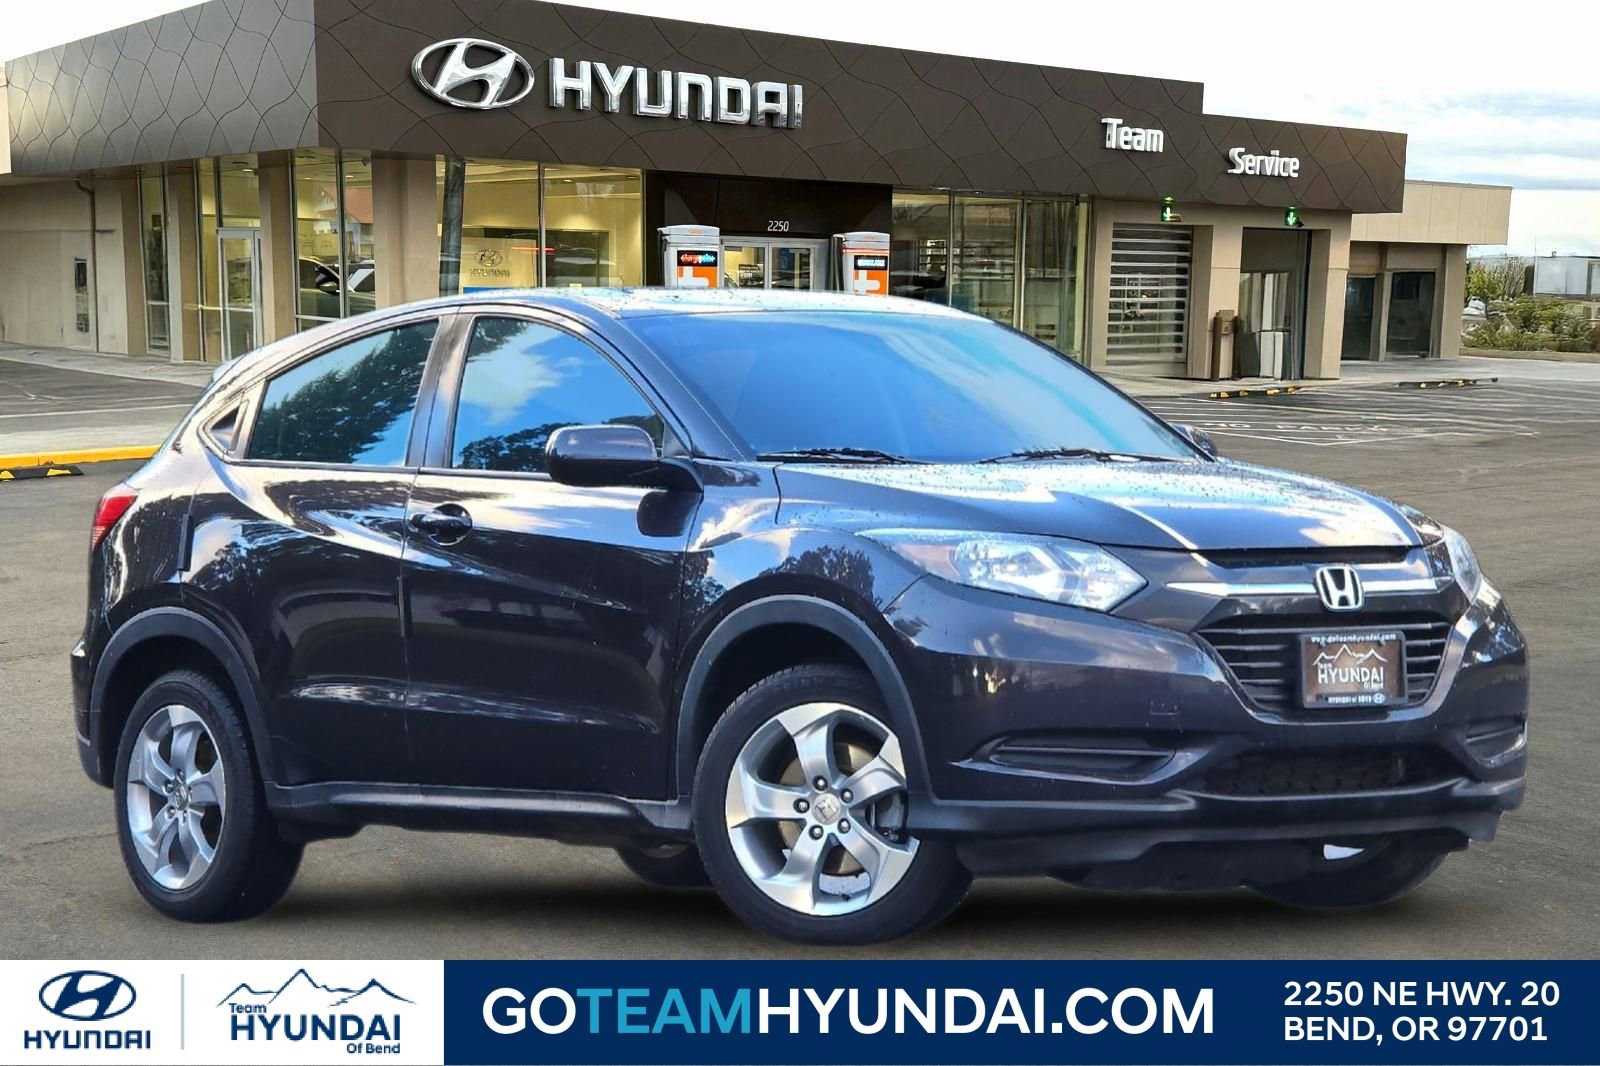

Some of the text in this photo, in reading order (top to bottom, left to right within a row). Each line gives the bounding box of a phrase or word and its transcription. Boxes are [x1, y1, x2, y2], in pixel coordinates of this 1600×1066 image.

[549, 57, 804, 129] HYUNDAI
[1101, 117, 1164, 153] Team
[1227, 147, 1300, 178] Service
[767, 220, 790, 232] 2250
[1317, 665, 1384, 685] HYUNDAI
